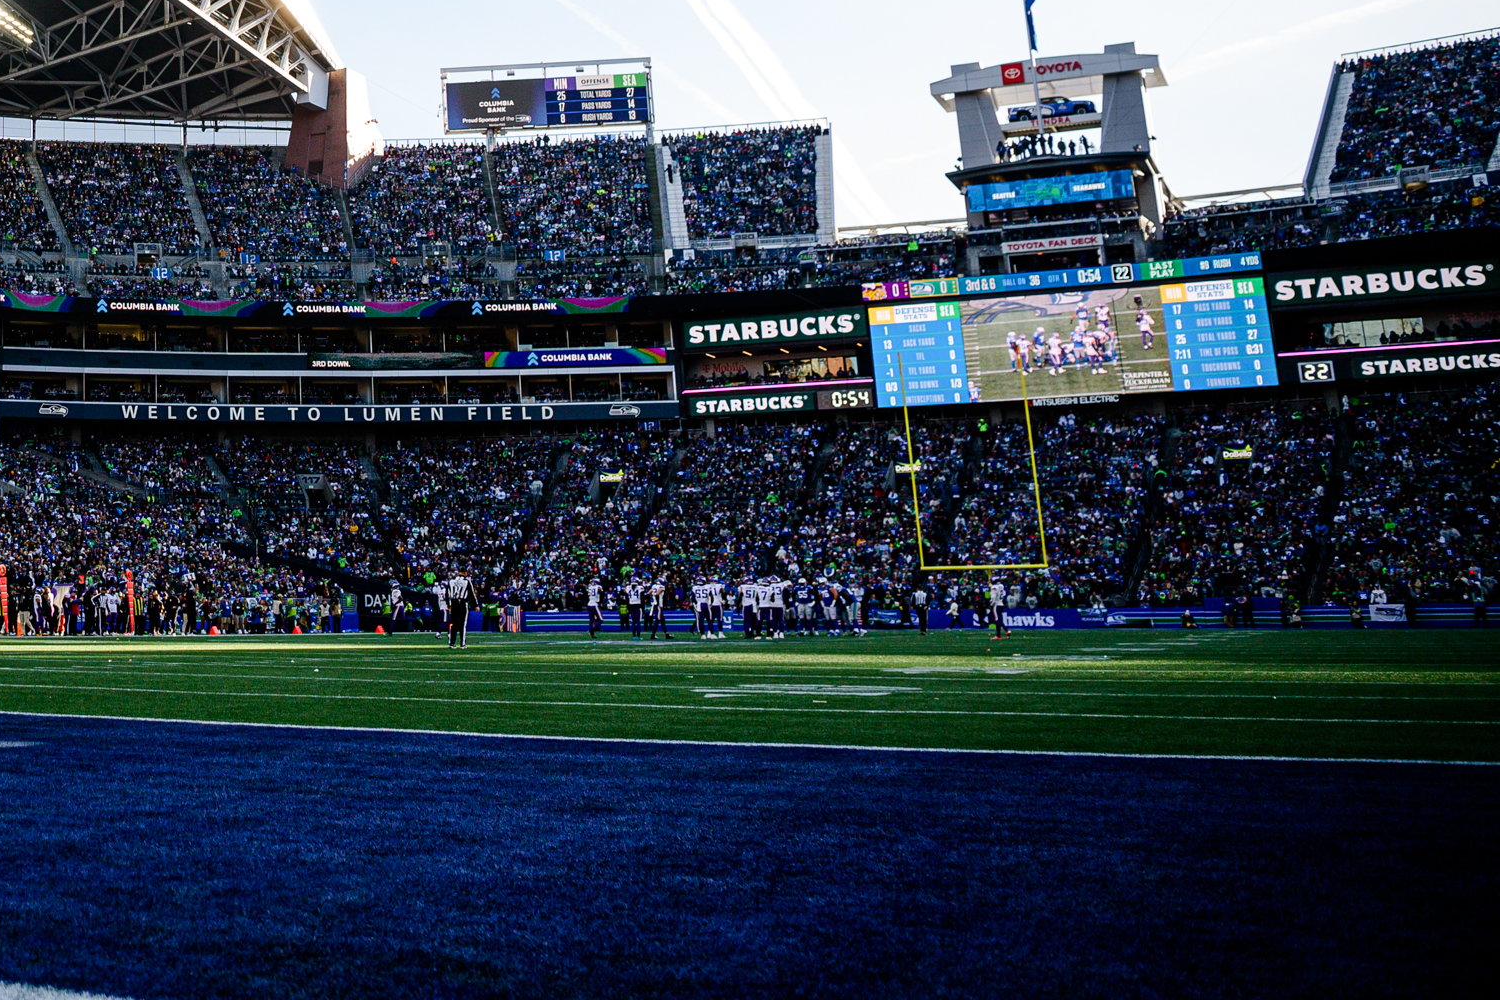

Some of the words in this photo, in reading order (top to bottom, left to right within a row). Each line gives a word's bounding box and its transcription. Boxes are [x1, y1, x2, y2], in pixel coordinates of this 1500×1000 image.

[1028, 61, 1083, 75] OYOTA
[553, 78, 567, 90] MIN
[622, 75, 636, 86] SEA
[556, 91, 566, 101] 25
[580, 91, 593, 99] TOTAL
[595, 90, 611, 98] YARDS
[626, 88, 635, 97] 27
[558, 102, 565, 112] 17
[582, 102, 594, 110] PASS
[595, 101, 611, 109] YARDS
[627, 99, 635, 109] 14
[479, 116, 499, 124] Sponsor
[582, 113, 597, 121] RUSH
[598, 112, 613, 120] YARDS
[628, 110, 636, 120] 13
[992, 191, 1015, 200] SEATTLE
[1073, 182, 1106, 192] SEAHAWKS
[1007, 242, 1045, 251] TOYOTA
[1049, 239, 1067, 247] FAN
[1071, 237, 1098, 246] DECK
[549, 250, 561, 261] 12
[1150, 261, 1173, 271] LAST
[1213, 258, 1231, 268] RUSH
[156, 268, 168, 279] 12
[1077, 268, 1102, 283] 0:54
[1115, 266, 1130, 280] 22
[1150, 269, 1175, 279] PLAY
[965, 279, 980, 291] 3rd
[1029, 275, 1040, 286] 36
[1275, 265, 1486, 301] STARBUCKS
[892, 284, 899, 297] 0
[940, 281, 947, 294] 0
[1166, 287, 1183, 300] MIN
[1187, 283, 1232, 293] OFFENSE
[1237, 281, 1254, 294] SEA
[1197, 290, 1224, 298] STATS
[110, 302, 155, 311] COLUMBIA
[156, 303, 179, 311] BANK
[296, 304, 342, 314] COLUMBIA
[343, 304, 366, 314] BANK
[485, 303, 531, 312] COLUMBIA
[533, 302, 557, 311] BANK
[895, 305, 935, 315] DEFENSE
[939, 304, 955, 317] SEA
[1172, 304, 1182, 315] 17
[1194, 303, 1210, 312] PASS
[1211, 301, 1231, 310] YARDS
[1244, 299, 1254, 310] 14
[876, 310, 891, 321] MIN
[1196, 318, 1212, 327] RUSH
[1214, 316, 1233, 326] YARDS
[1246, 314, 1257, 325] 13
[689, 314, 855, 344] STARBUCKS
[909, 324, 926, 333] SACKS
[1176, 334, 1187, 345] 25
[1197, 333, 1215, 342] TOTAL
[1216, 331, 1236, 341] YARDS
[1247, 329, 1258, 340] 27
[883, 340, 892, 350] 13
[903, 338, 917, 348] SACK
[918, 337, 935, 346] YARDS
[541, 354, 586, 363] COLUMBIA
[587, 353, 612, 362] BANK
[1174, 349, 1192, 360] 7:11
[1199, 348, 1214, 357] TIME
[1246, 344, 1264, 354] 6:31
[312, 360, 325, 368] 3RD
[1201, 362, 1241, 372] TOUCHDOWNS
[1361, 353, 1500, 375] STARBUCKS
[918, 366, 936, 375] YARDS
[1123, 371, 1162, 379] CARPENTER
[1304, 363, 1329, 380] 22
[885, 382, 898, 392] 0/3
[920, 380, 939, 389] DOWNS
[950, 378, 962, 388] 1/3
[1124, 378, 1170, 386] ZUCKERMAN
[1206, 376, 1240, 387] TURNOVERS
[696, 396, 805, 413] STARBUCKS
[831, 391, 869, 408] 0:54
[1032, 397, 1078, 407] MITSUBISHI
[1080, 394, 1119, 404] ELECTRIC
[121, 405, 265, 421] WELCOME
[288, 407, 321, 422] TO
[344, 407, 444, 422] LUMEN
[468, 406, 555, 420] FIELD
[696, 589, 708, 598] 55
[798, 590, 808, 598] 55
